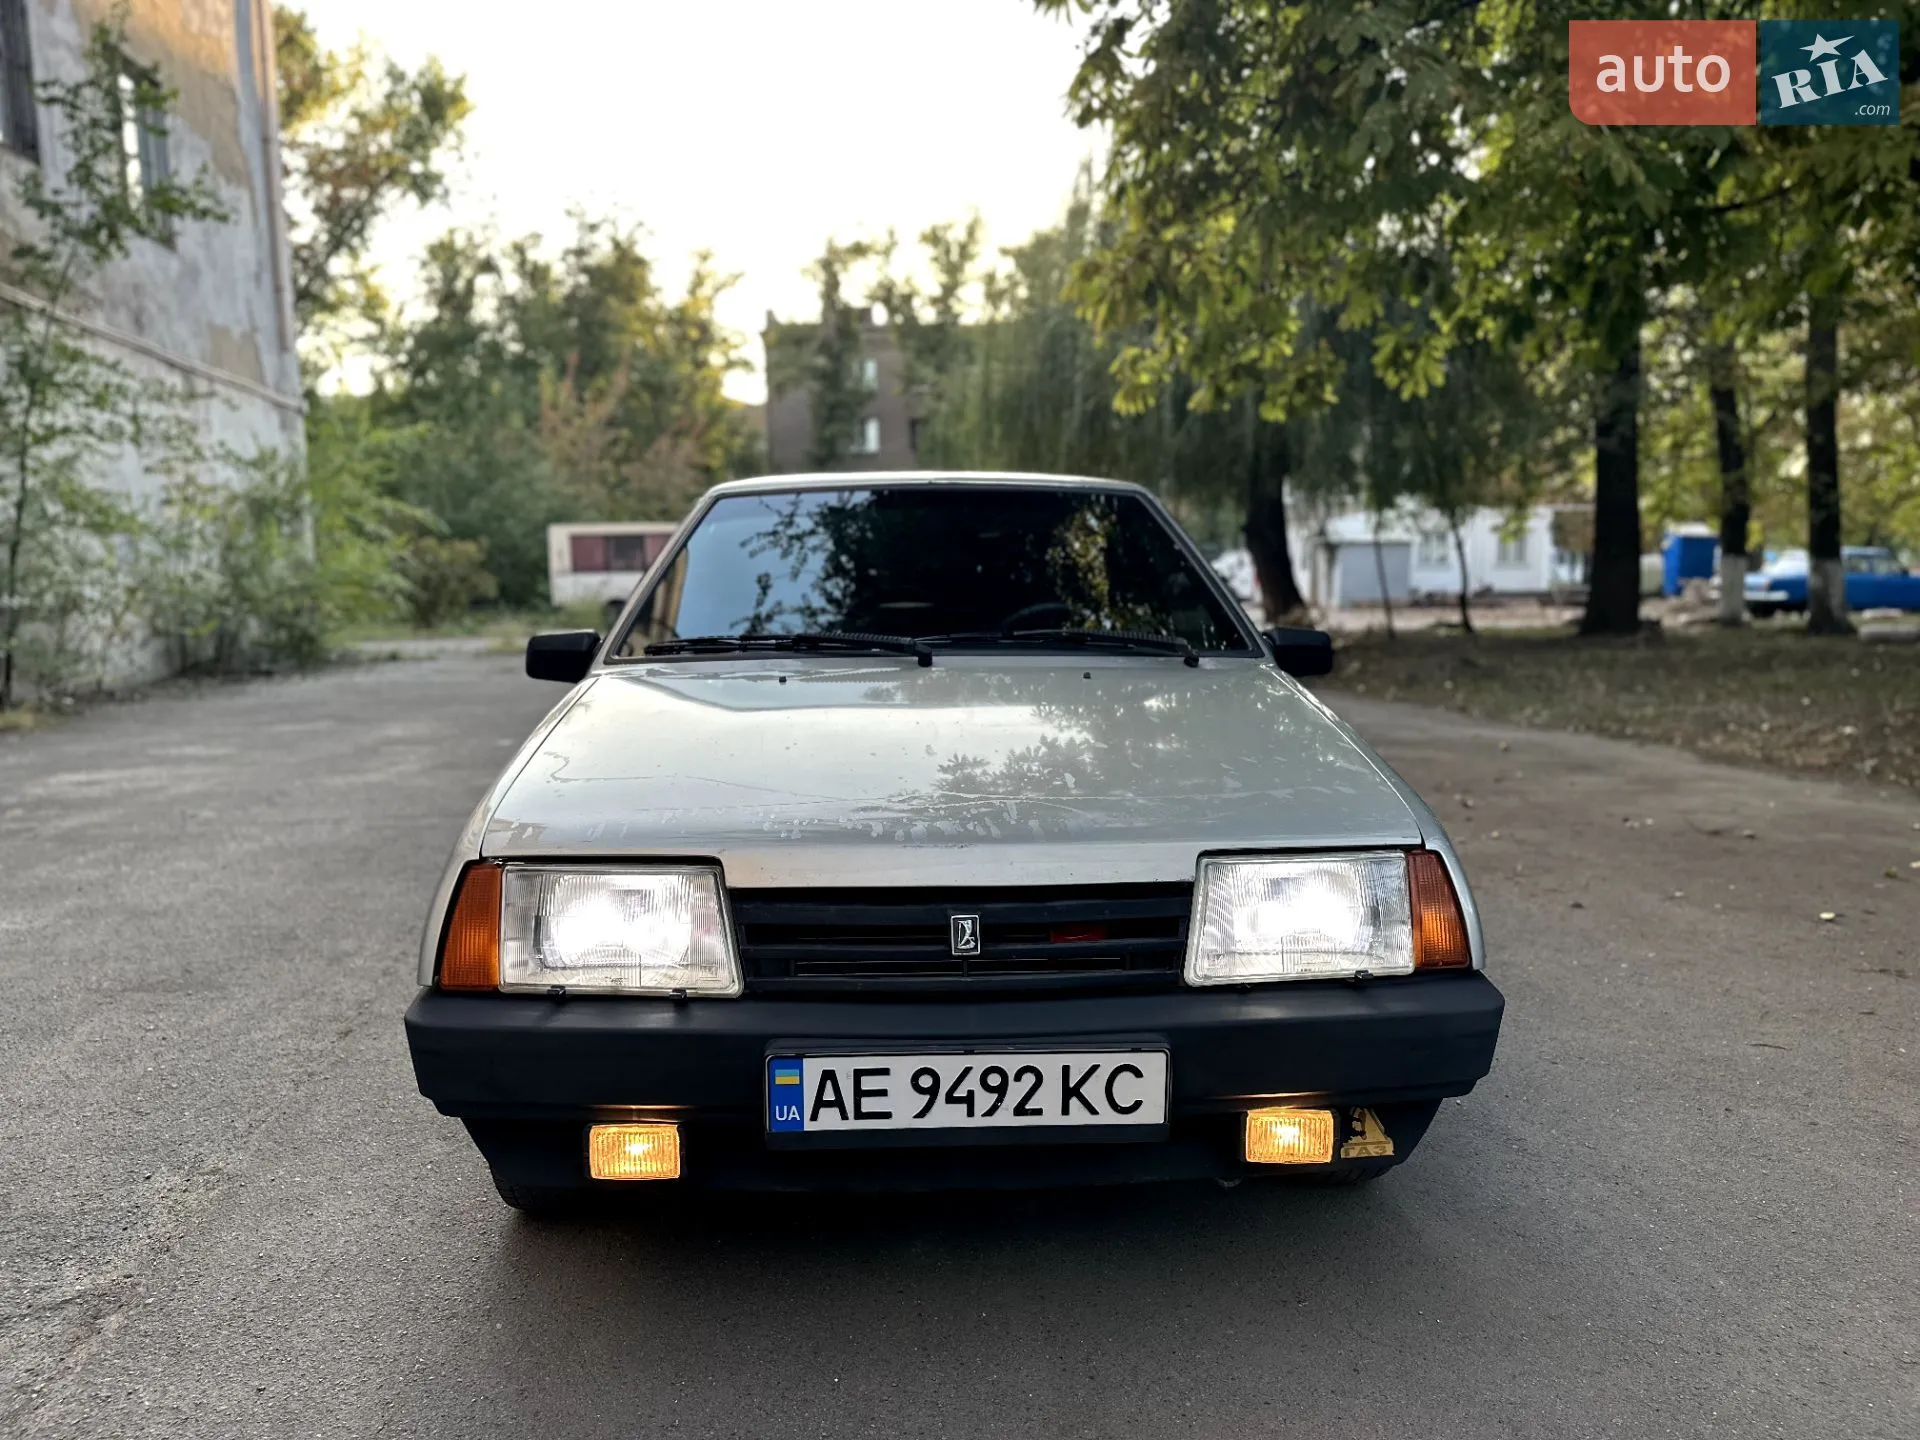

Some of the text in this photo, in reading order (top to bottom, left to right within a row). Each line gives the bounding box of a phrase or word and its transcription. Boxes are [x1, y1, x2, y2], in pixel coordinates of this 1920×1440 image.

[809, 1063, 1143, 1121] AE 9492 KC
[774, 1105, 801, 1121] UA
[1344, 1145, 1388, 1156] ГАЗ
